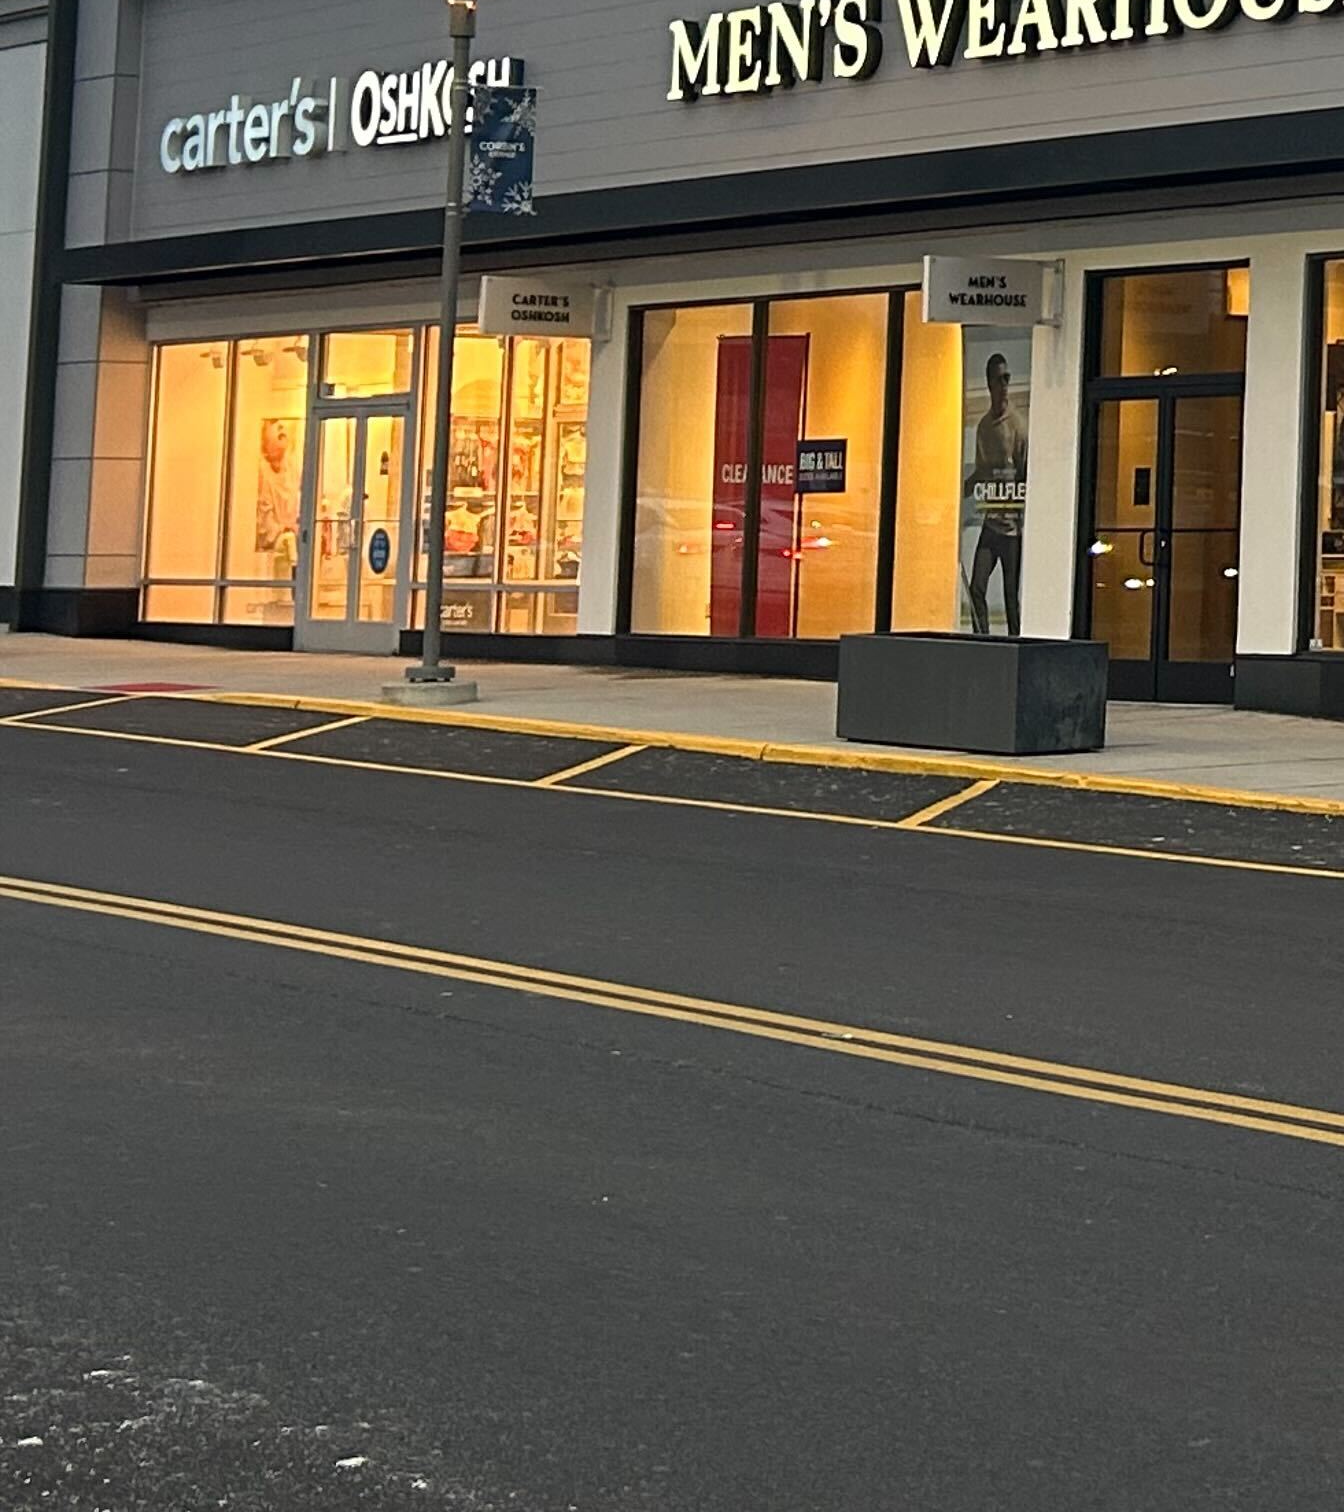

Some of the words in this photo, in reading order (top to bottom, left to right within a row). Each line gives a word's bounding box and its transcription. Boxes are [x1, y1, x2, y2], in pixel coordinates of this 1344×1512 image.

[160, 76, 316, 174] carter's
[967, 274, 1008, 289] MEN'S
[511, 294, 570, 308] CARTER'S
[948, 292, 1028, 308] WEARHOUSE
[510, 309, 571, 324] OSHKOSH
